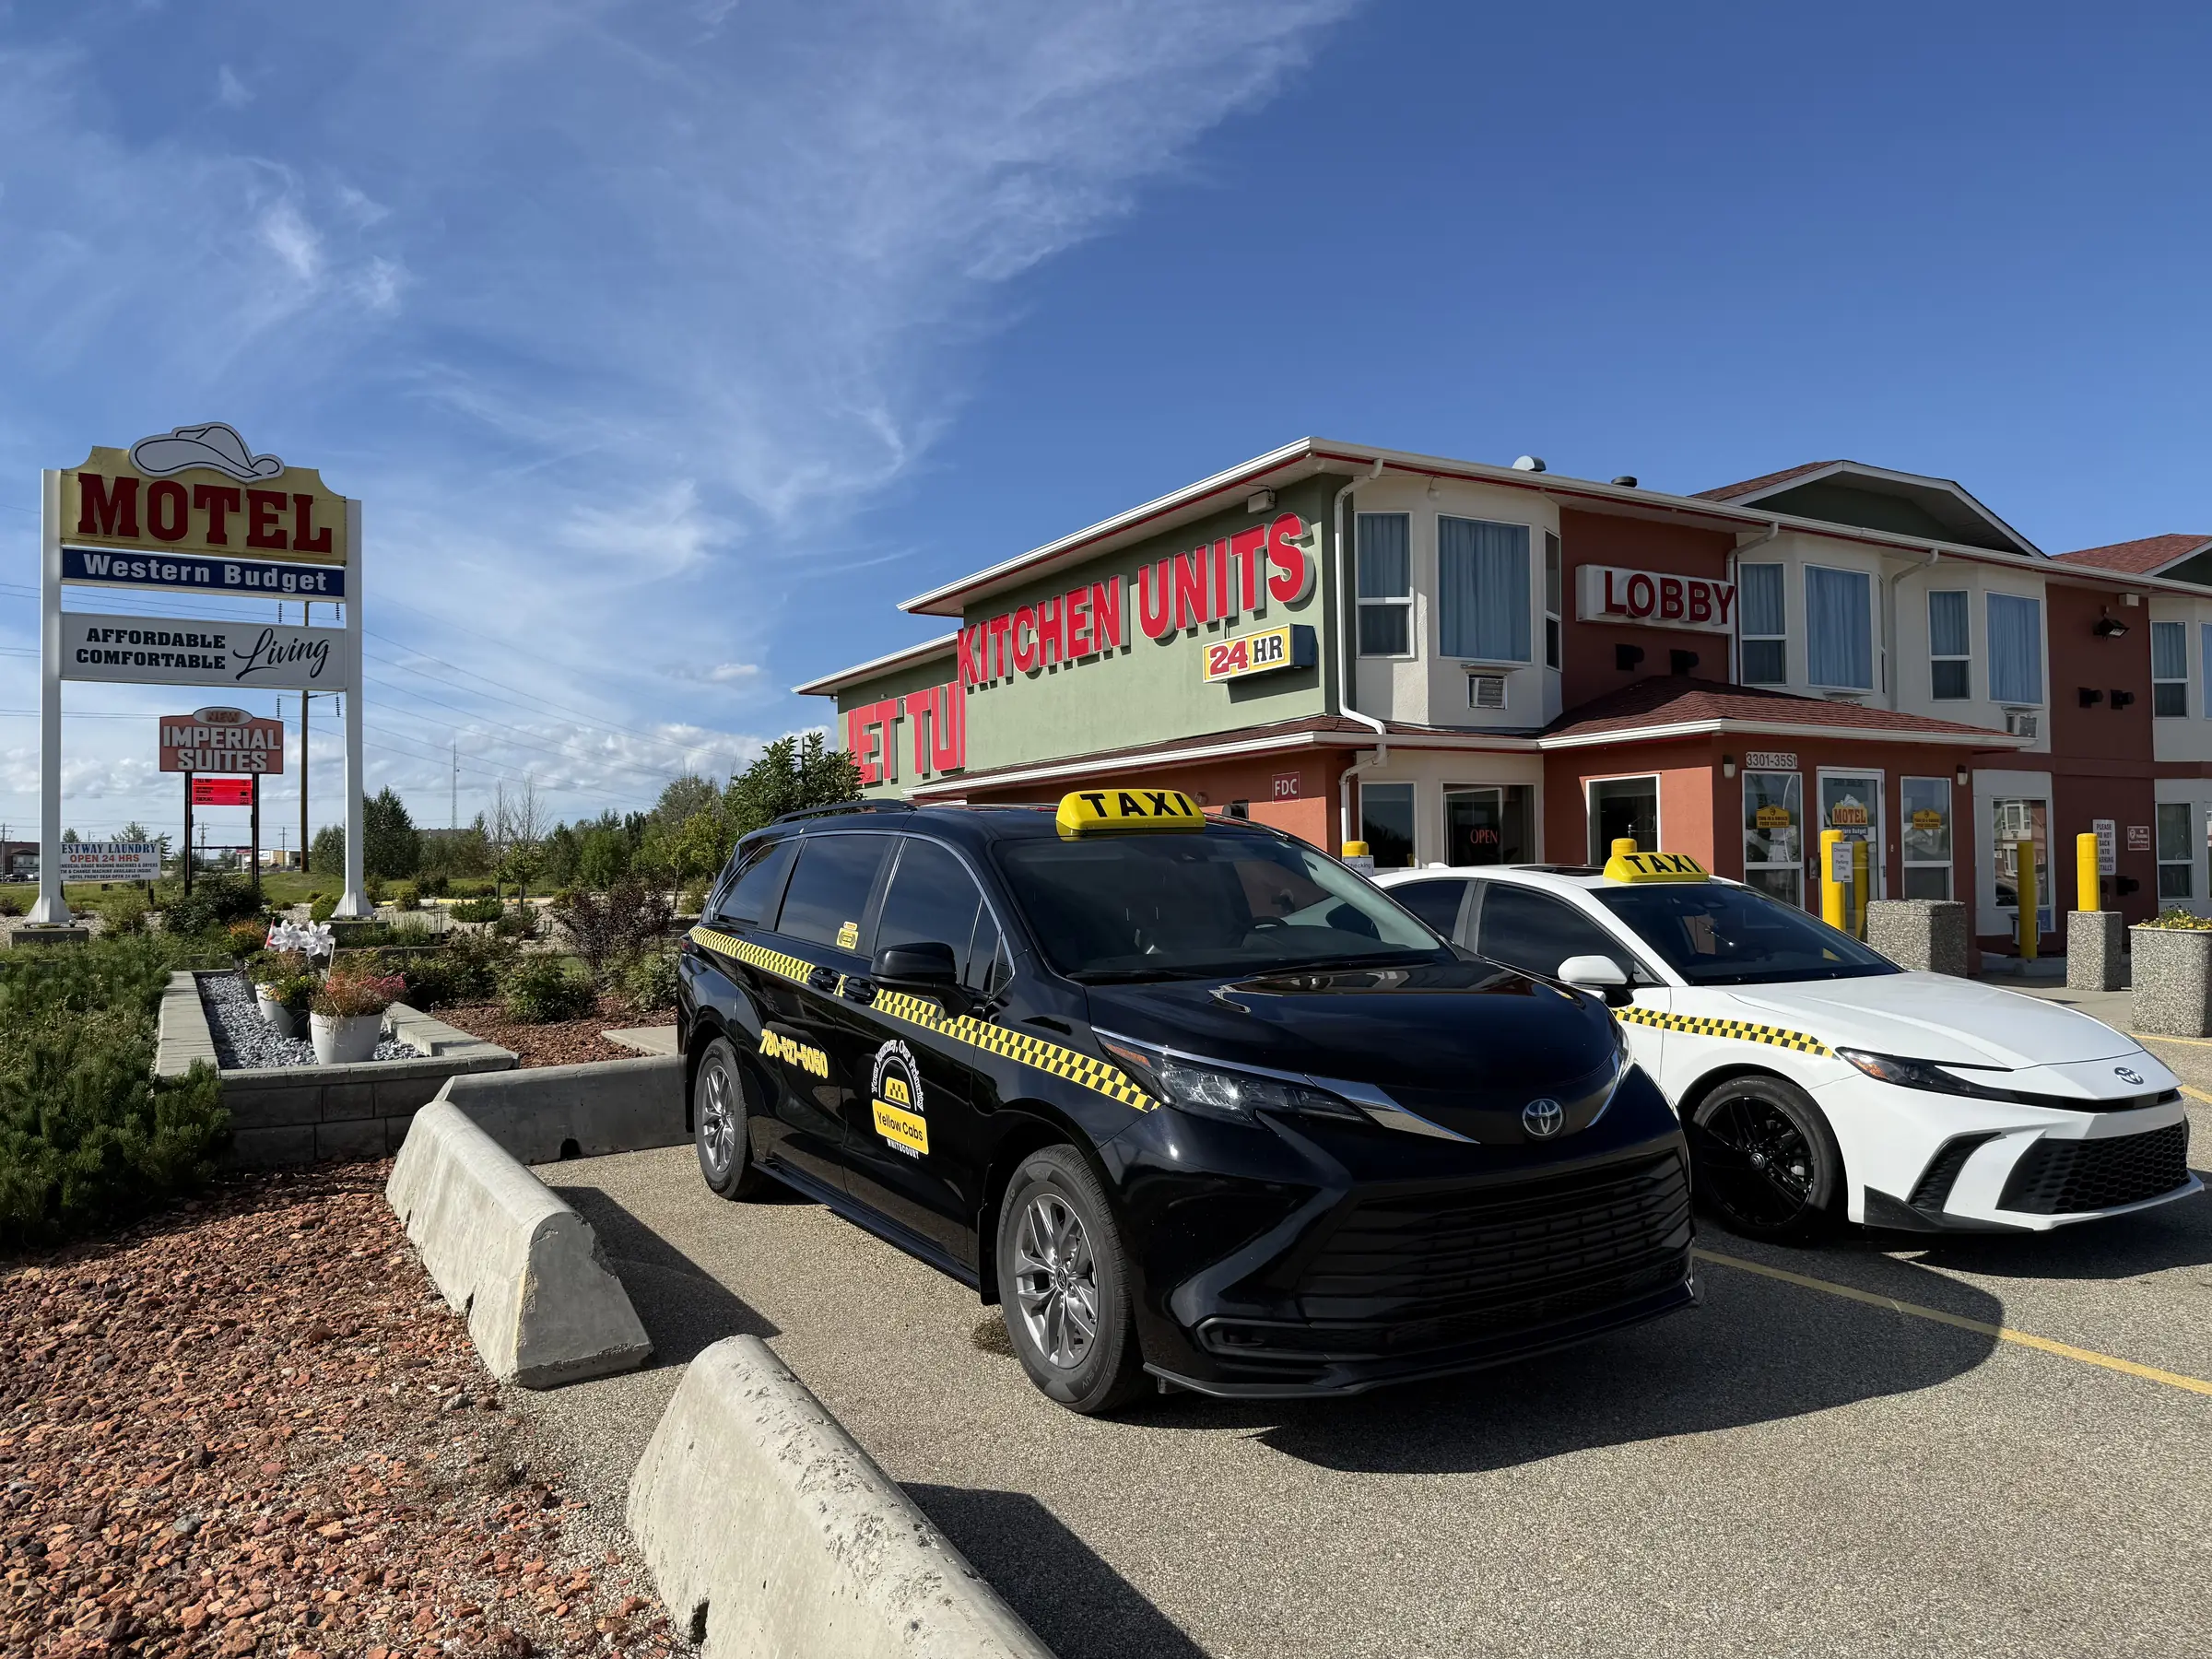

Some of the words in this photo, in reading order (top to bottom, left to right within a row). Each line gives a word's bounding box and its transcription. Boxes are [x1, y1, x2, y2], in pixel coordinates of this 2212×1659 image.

[77, 472, 332, 553] MOTEL
[83, 553, 210, 582] Western
[224, 564, 326, 593] Budget
[958, 575, 1124, 688] KITCHEN
[1138, 512, 1309, 639] UNITS
[1604, 570, 1736, 625] LOBBY
[86, 627, 226, 649] AFFORDABLE
[76, 648, 226, 670] COMFORTABLE
[232, 628, 331, 681] Living
[1209, 641, 1248, 676] 24
[1253, 635, 1283, 663] HR
[206, 711, 242, 723] NEW
[163, 725, 280, 749] IMPERIAL
[177, 748, 267, 771] SUITES
[1746, 752, 1797, 768] 3301-35St
[1275, 778, 1298, 796] FDC
[1079, 792, 1194, 818] TAXI
[1833, 807, 1866, 824] MOTEL
[61, 843, 103, 853] ESTWAY
[108, 843, 157, 853] LAUNDRY
[1470, 829, 1499, 845] OPEN
[69, 854, 99, 863] OPEN
[102, 854, 115, 863] 24
[118, 853, 140, 863] HRS
[1622, 853, 1702, 874] TAXI
[871, 1061, 879, 1094] Your
[898, 1039, 912, 1062] Our
[877, 1110, 902, 1134] Yellow
[902, 1121, 924, 1142] Cabs
